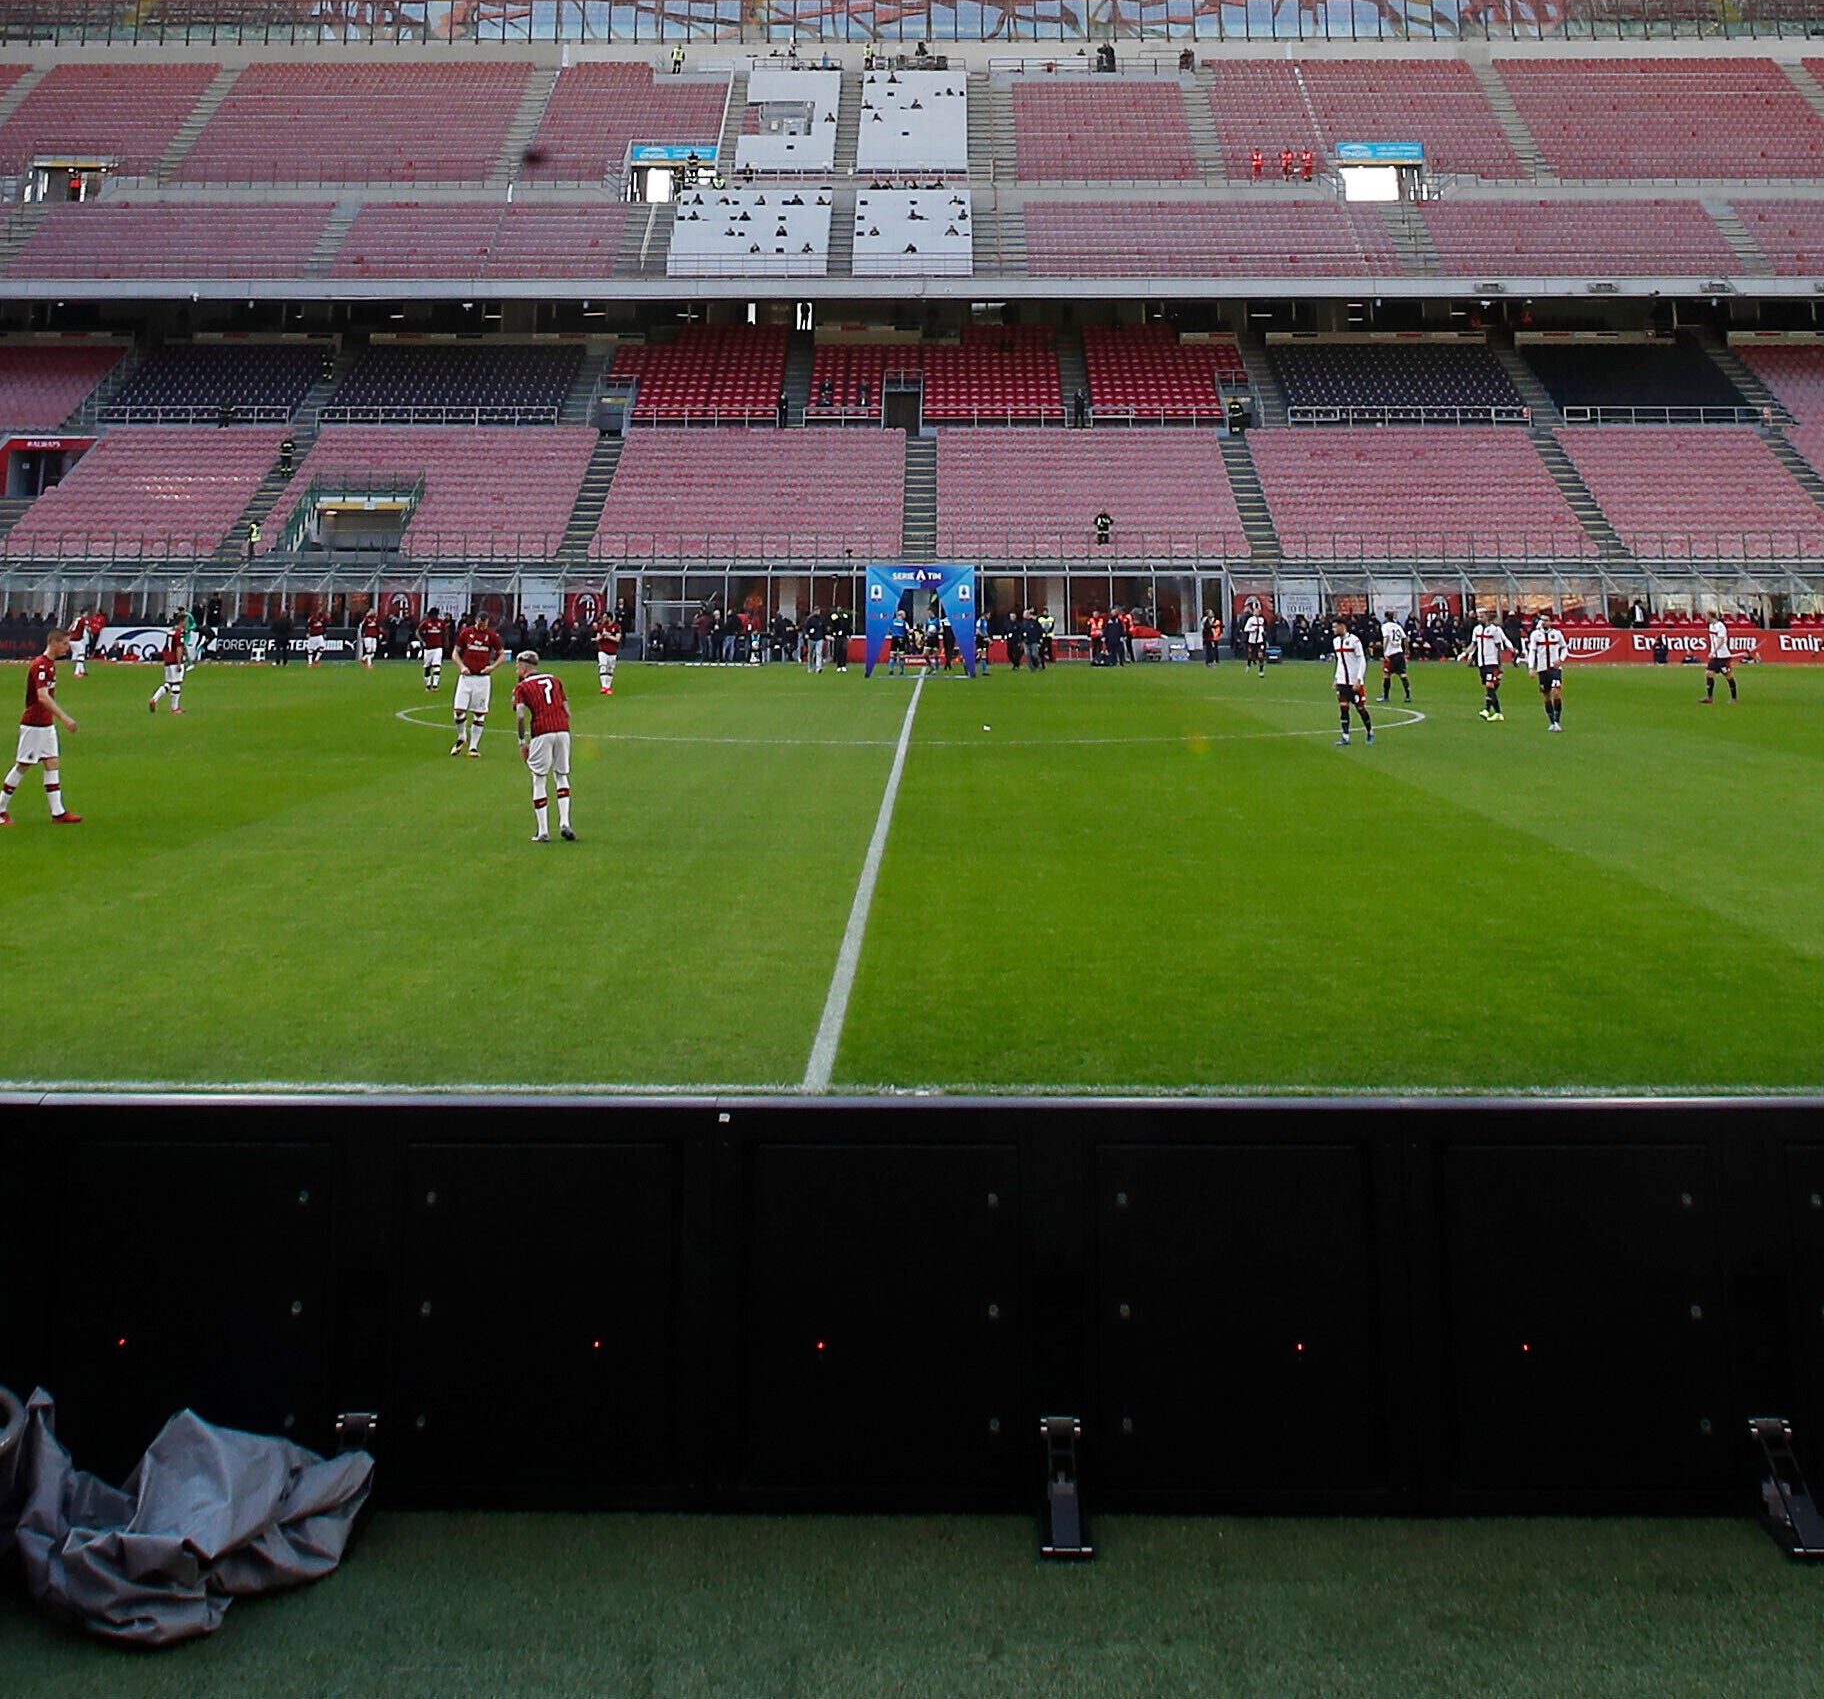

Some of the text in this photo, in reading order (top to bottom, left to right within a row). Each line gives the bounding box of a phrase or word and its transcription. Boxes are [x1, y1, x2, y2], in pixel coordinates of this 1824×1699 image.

[892, 569, 942, 581] SERIE A TIM
[1391, 629, 1402, 642] 19
[217, 638, 309, 651] FOREVER FTER
[1583, 636, 1611, 650] BETTER
[1729, 636, 1757, 650] BETTER
[537, 678, 553, 704] 7
